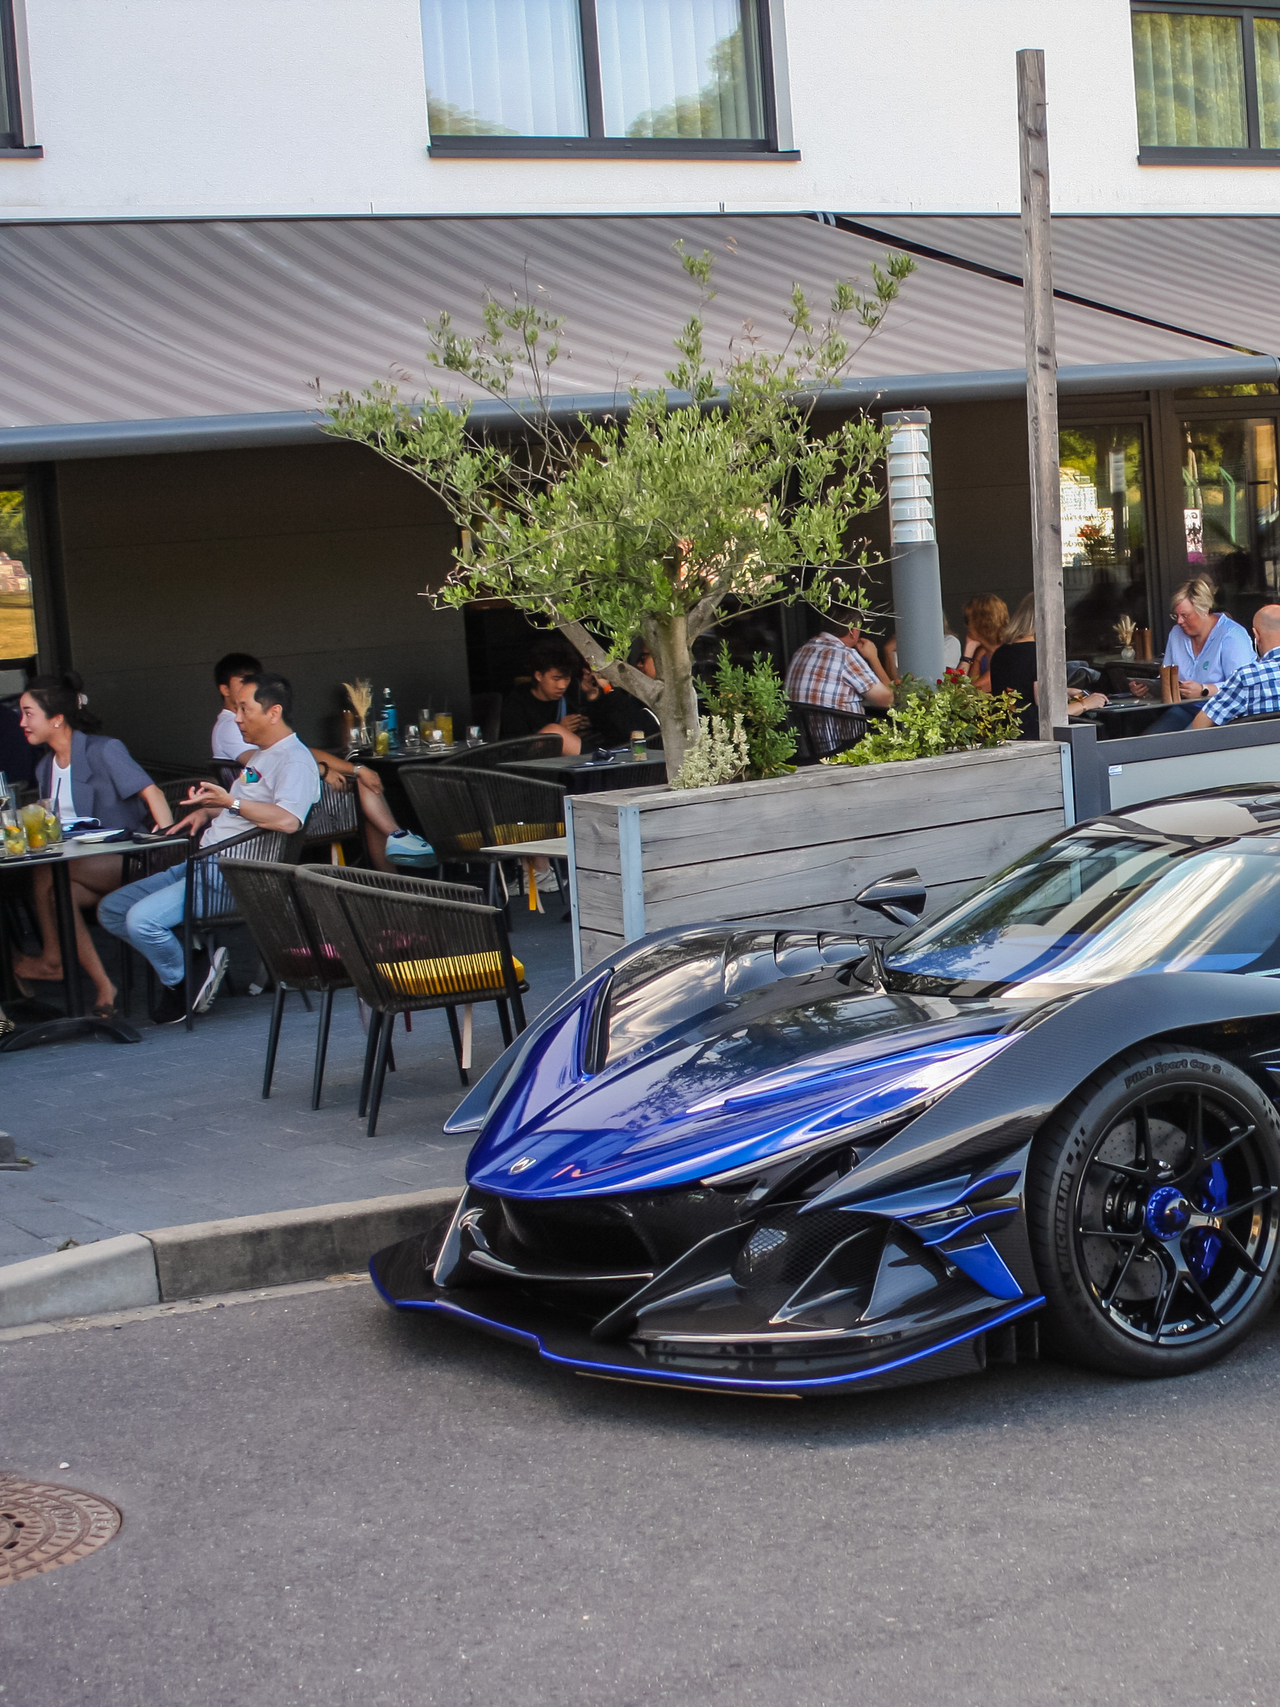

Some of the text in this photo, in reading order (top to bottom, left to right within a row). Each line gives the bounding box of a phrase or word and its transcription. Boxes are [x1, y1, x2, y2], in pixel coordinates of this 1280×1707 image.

[1124, 1059, 1222, 1089] Pilot Sport Cup 2
[1055, 1171, 1075, 1273] MICHELIN
